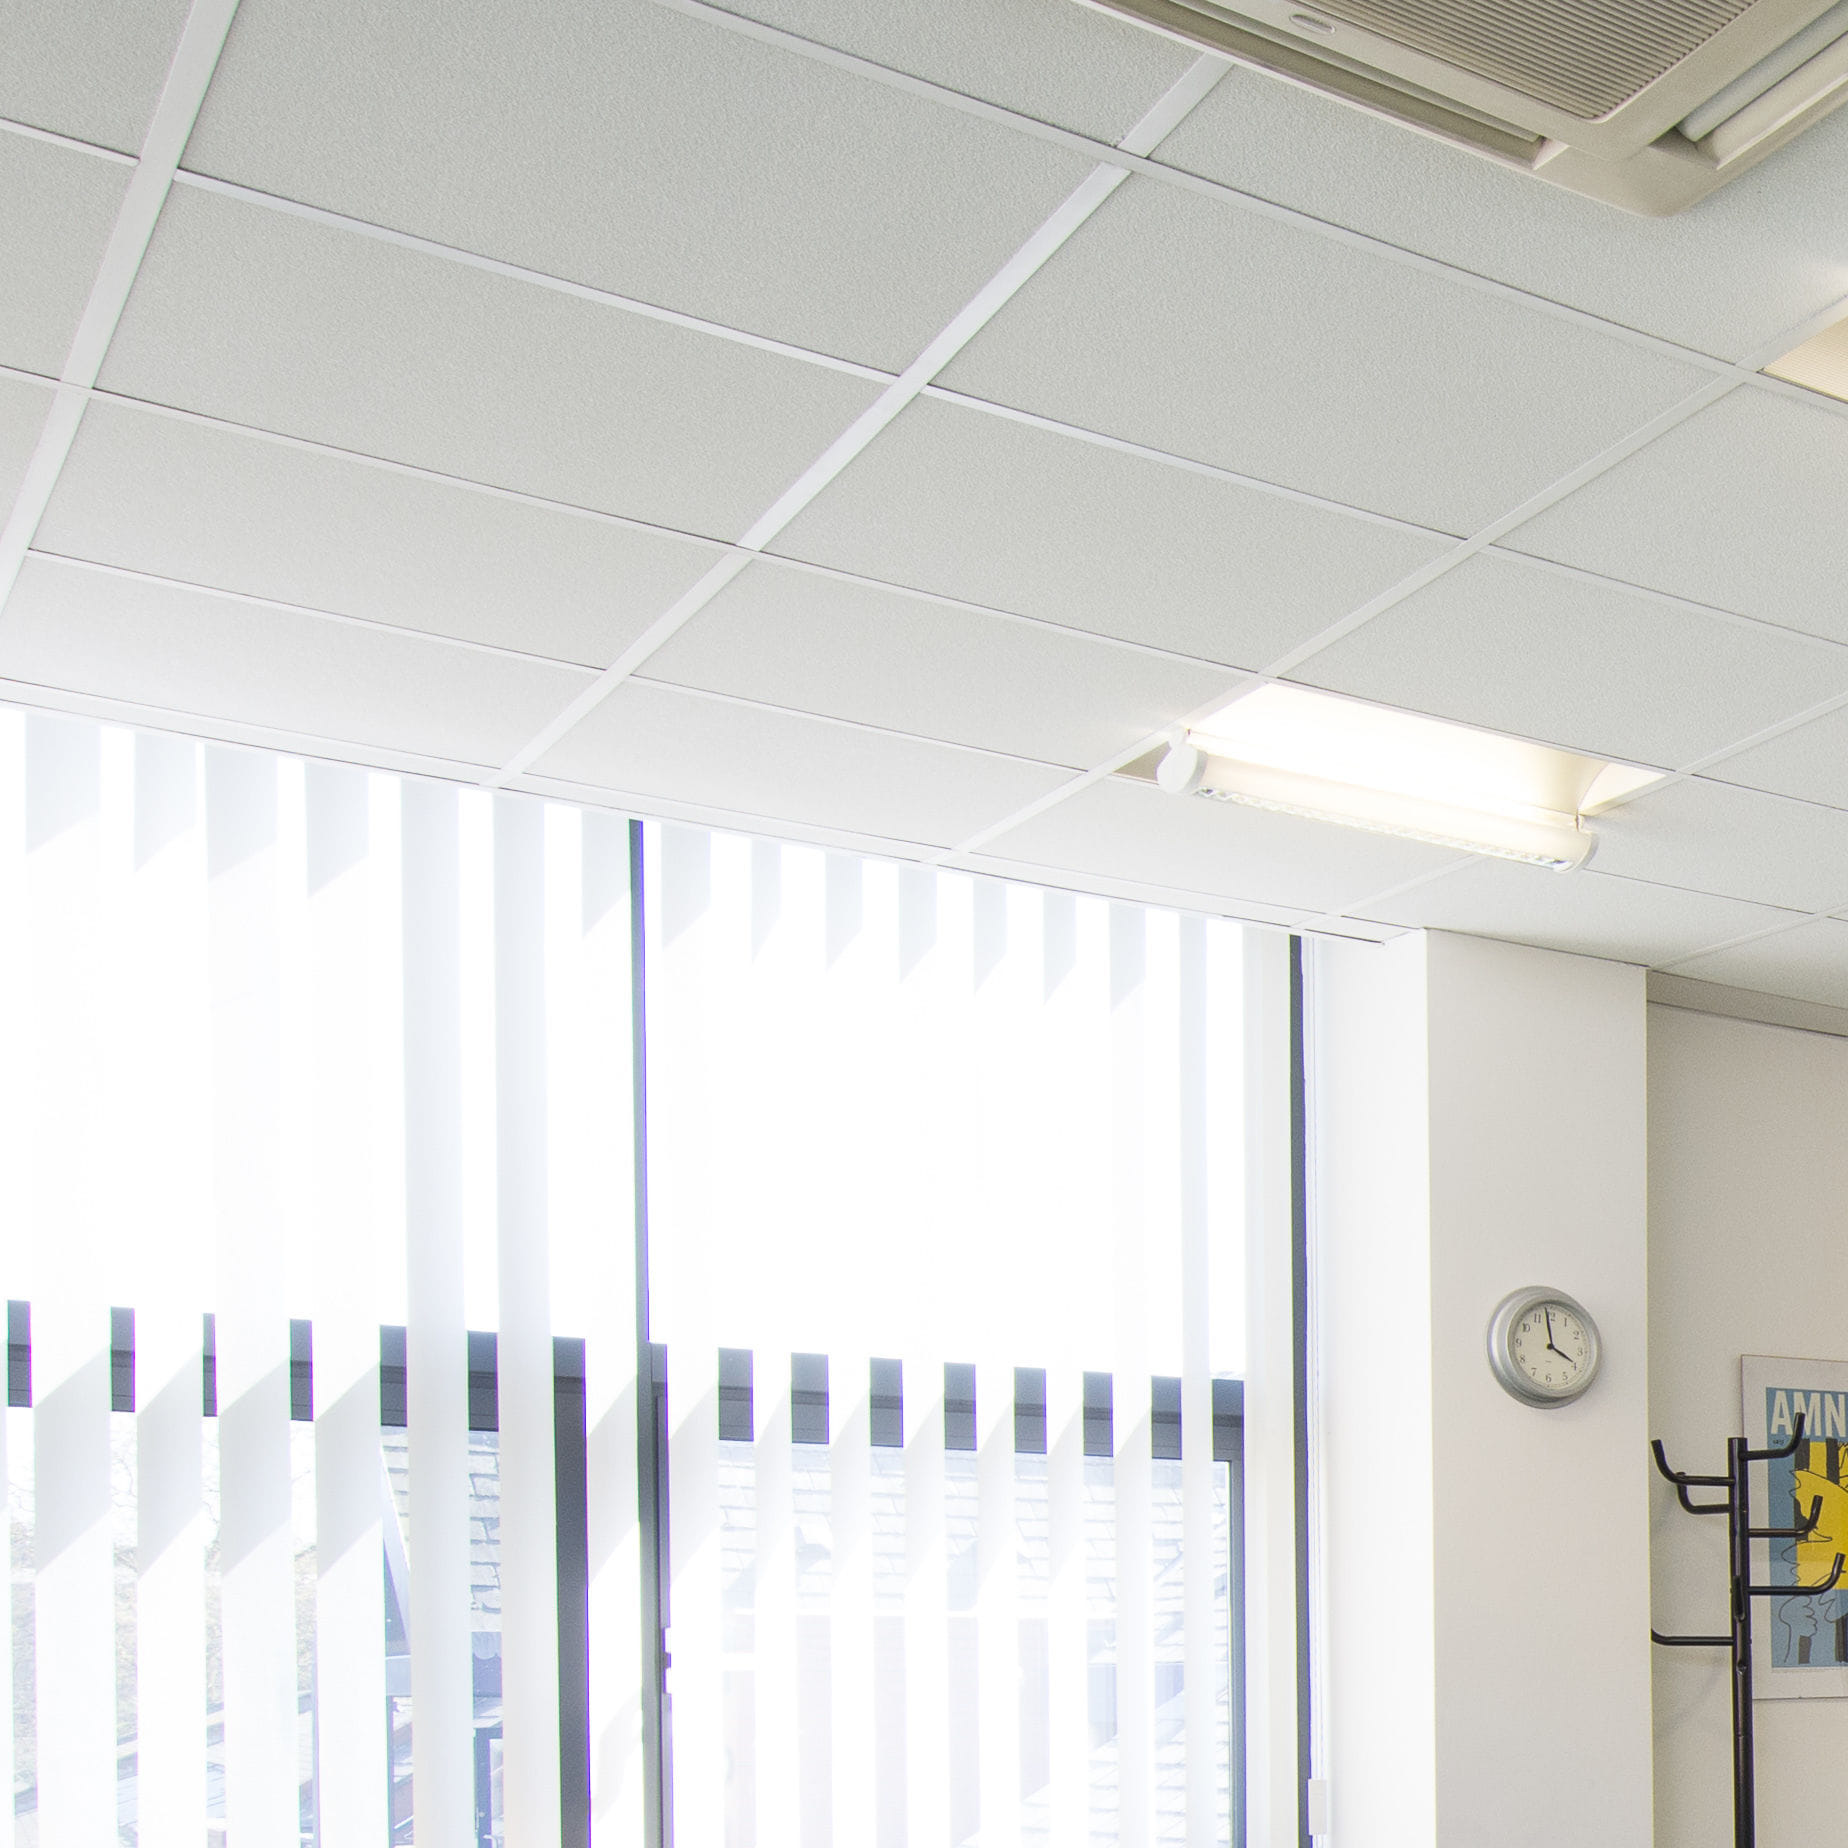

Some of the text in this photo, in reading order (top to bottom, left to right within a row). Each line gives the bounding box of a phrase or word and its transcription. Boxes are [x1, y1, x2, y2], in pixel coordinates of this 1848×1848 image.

[1533, 1313, 1541, 1324] 11
[1522, 1323, 1531, 1332] 10
[1572, 1331, 1580, 1340] 2
[1577, 1347, 1583, 1356] 3
[1531, 1367, 1538, 1377] 7
[1545, 1373, 1552, 1383] 6
